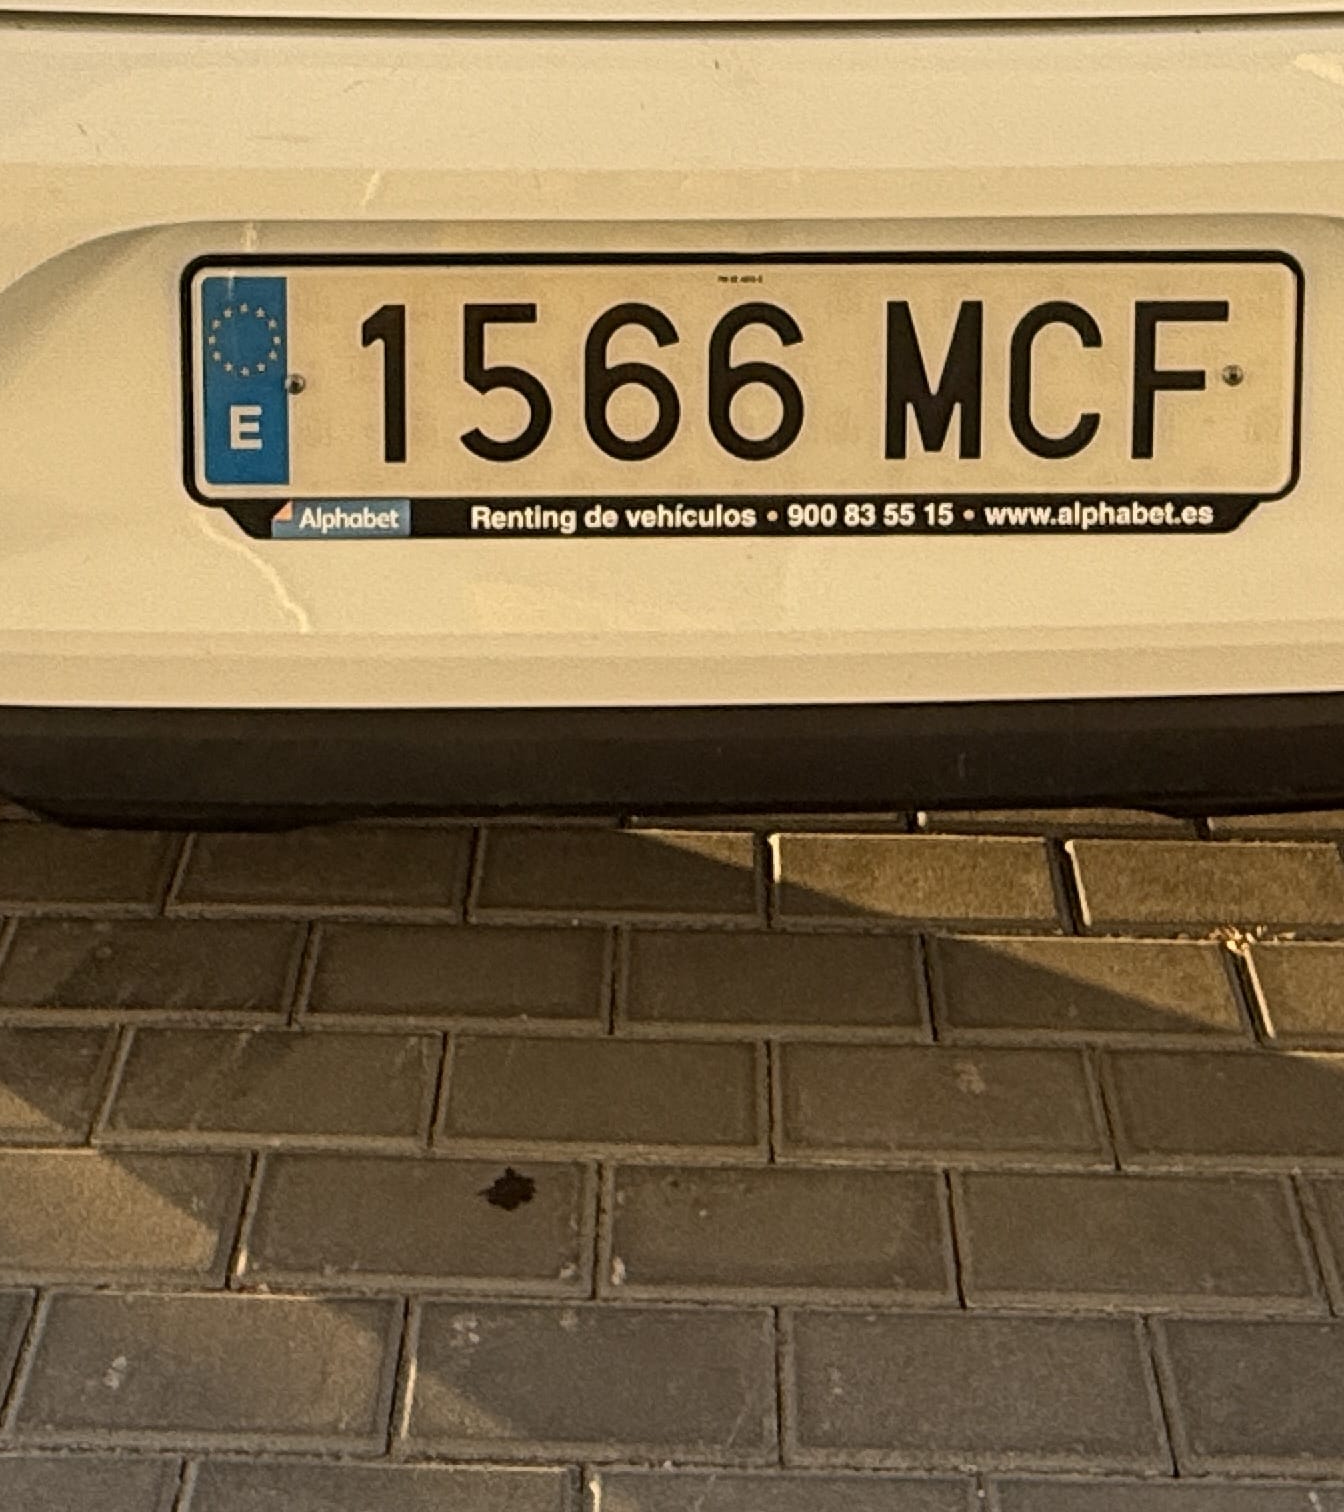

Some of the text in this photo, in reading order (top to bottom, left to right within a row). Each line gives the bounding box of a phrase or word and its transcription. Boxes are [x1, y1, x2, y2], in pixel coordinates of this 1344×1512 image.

[361, 299, 1229, 464] 1566 MCF
[229, 405, 263, 449] E
[299, 506, 400, 532] Alphabet
[471, 502, 1214, 533] Renting de vehículos 900 83 55 15 www.alphabet.es
